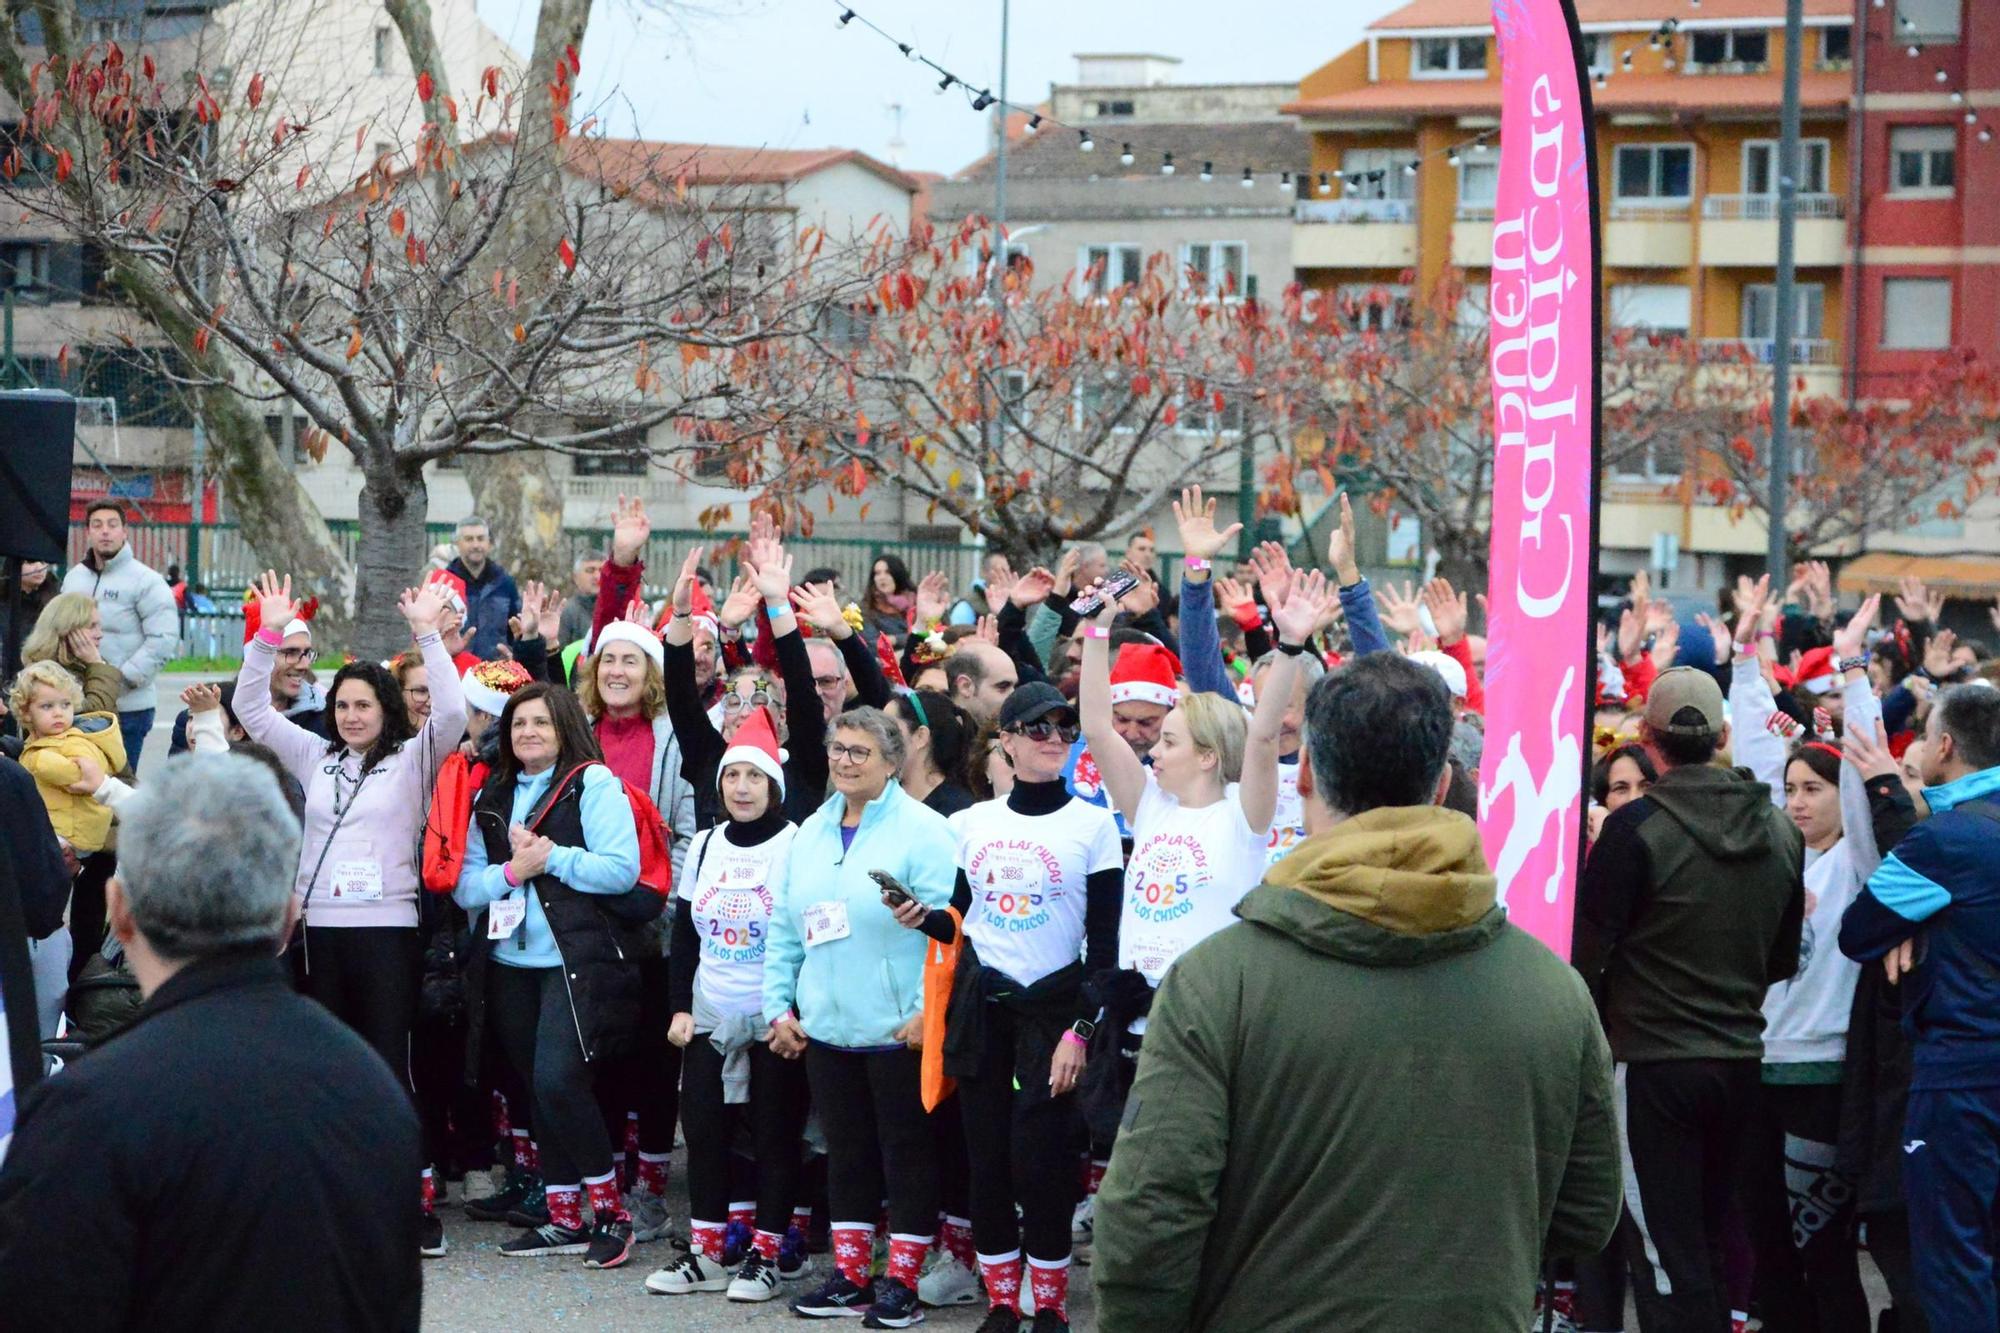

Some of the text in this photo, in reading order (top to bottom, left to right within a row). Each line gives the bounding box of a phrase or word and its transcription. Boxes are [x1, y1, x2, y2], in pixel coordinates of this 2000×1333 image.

[1008, 839, 1033, 850] LAS
[1034, 845, 1063, 883] CHICAS
[696, 886, 720, 913] EQUI
[1135, 871, 1188, 905] 2025
[987, 911, 1007, 929] LOS
[1009, 909, 1050, 932] CHICOS
[1135, 902, 1152, 920] LOS
[1154, 898, 1194, 923] CHICOS
[709, 919, 761, 946] 2025
[713, 945, 732, 960] LOS
